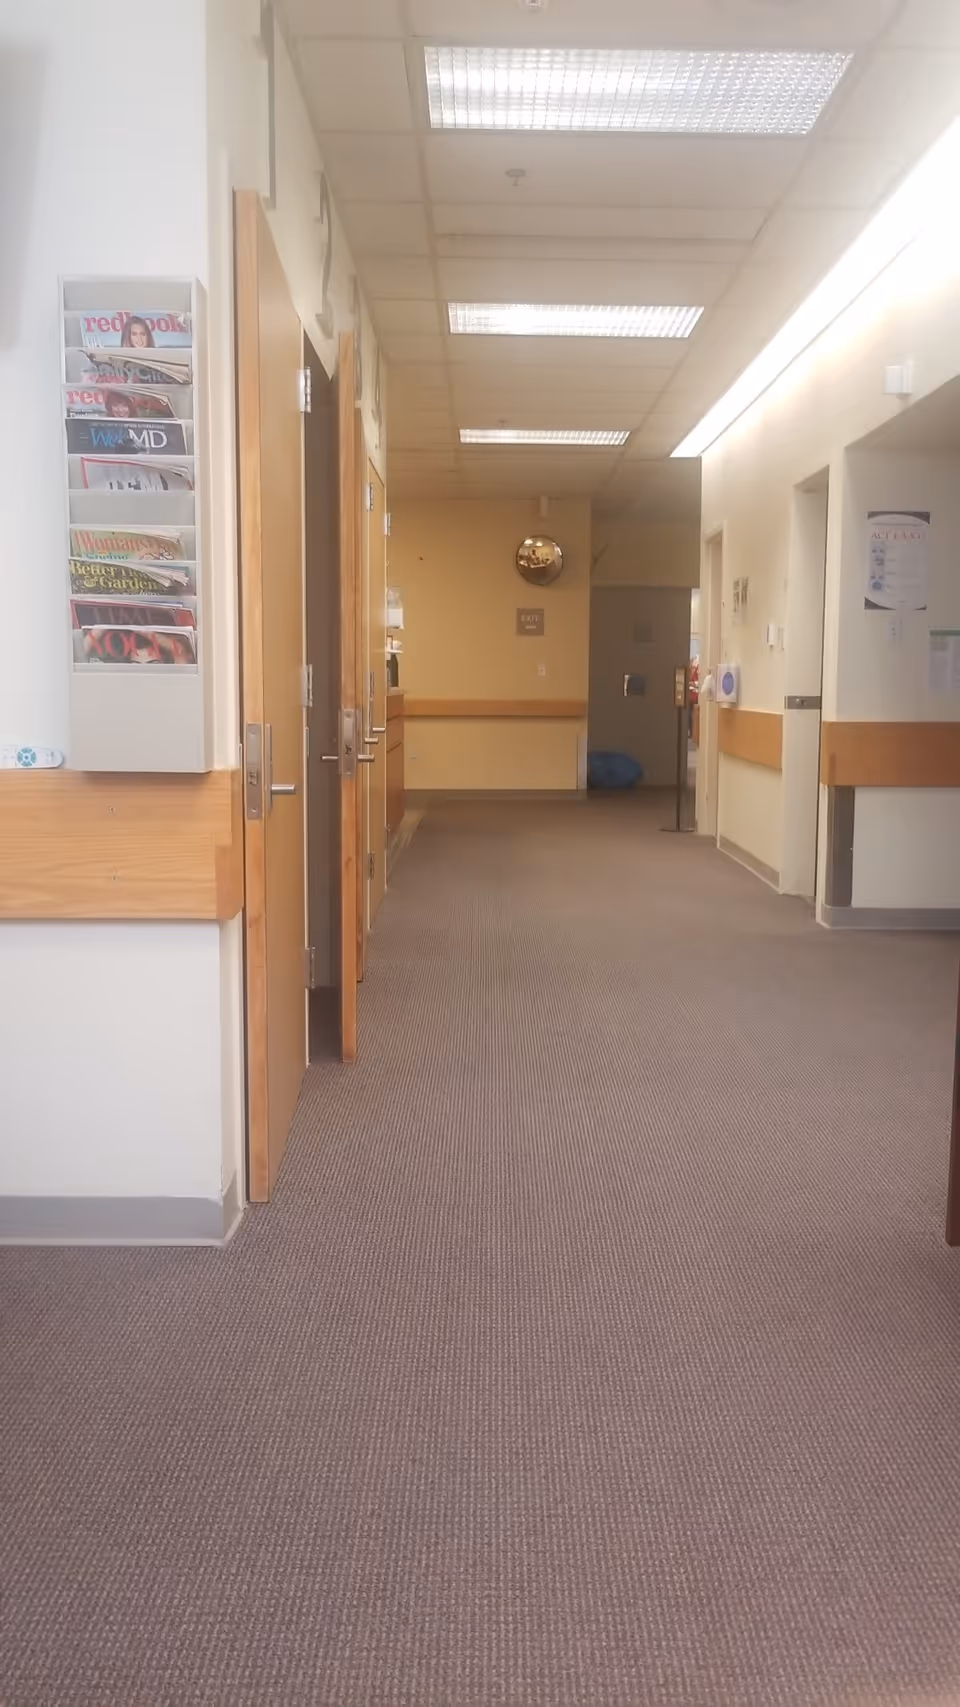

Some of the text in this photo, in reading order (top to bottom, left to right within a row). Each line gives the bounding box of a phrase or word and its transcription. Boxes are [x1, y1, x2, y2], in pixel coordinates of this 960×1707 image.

[69, 560, 118, 577] Better
[83, 576, 164, 592] & Garden
